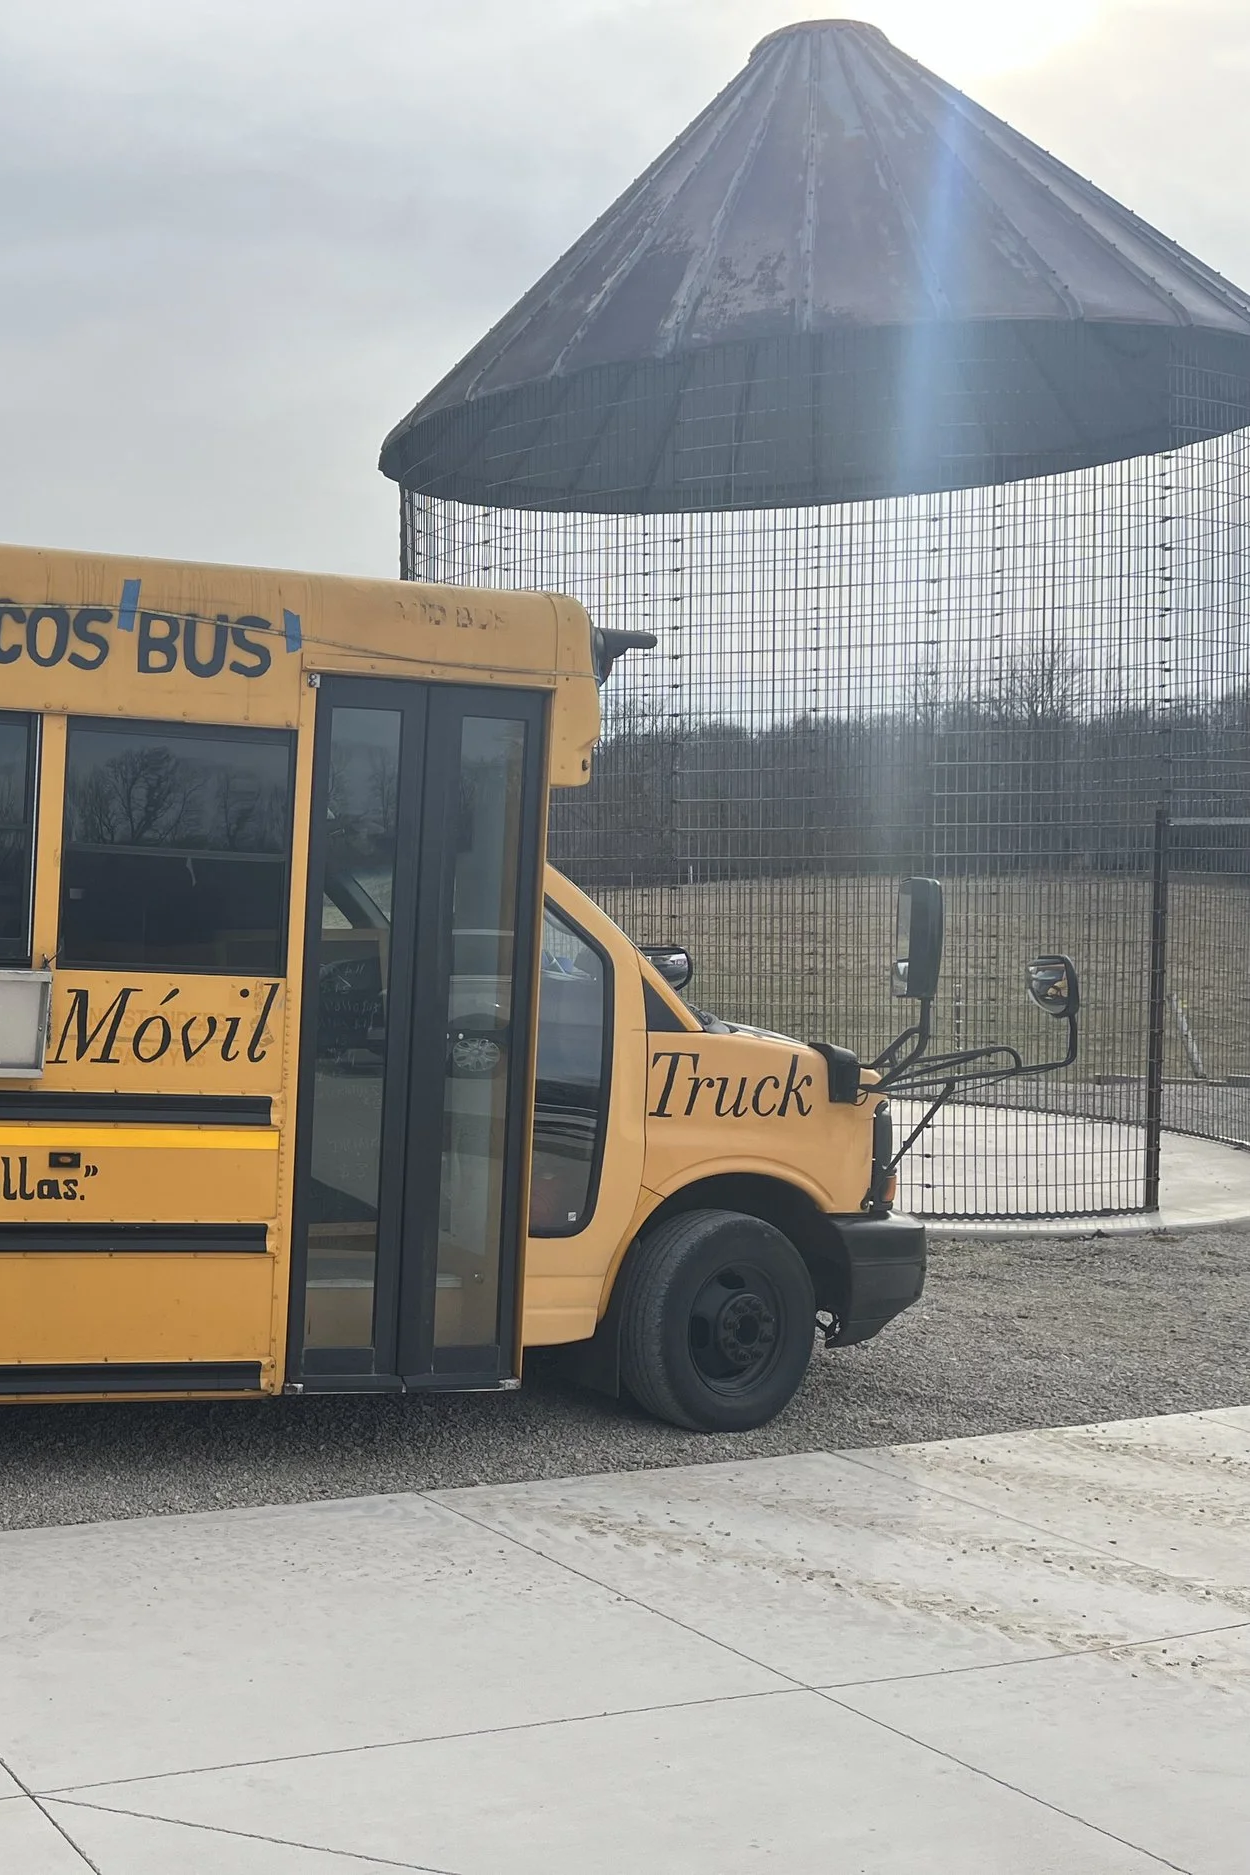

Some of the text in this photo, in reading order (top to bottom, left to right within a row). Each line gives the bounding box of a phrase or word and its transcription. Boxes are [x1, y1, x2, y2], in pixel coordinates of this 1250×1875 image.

[137, 612, 272, 678] BUS
[46, 983, 281, 1064] Móvil
[648, 1052, 813, 1118] Truck
